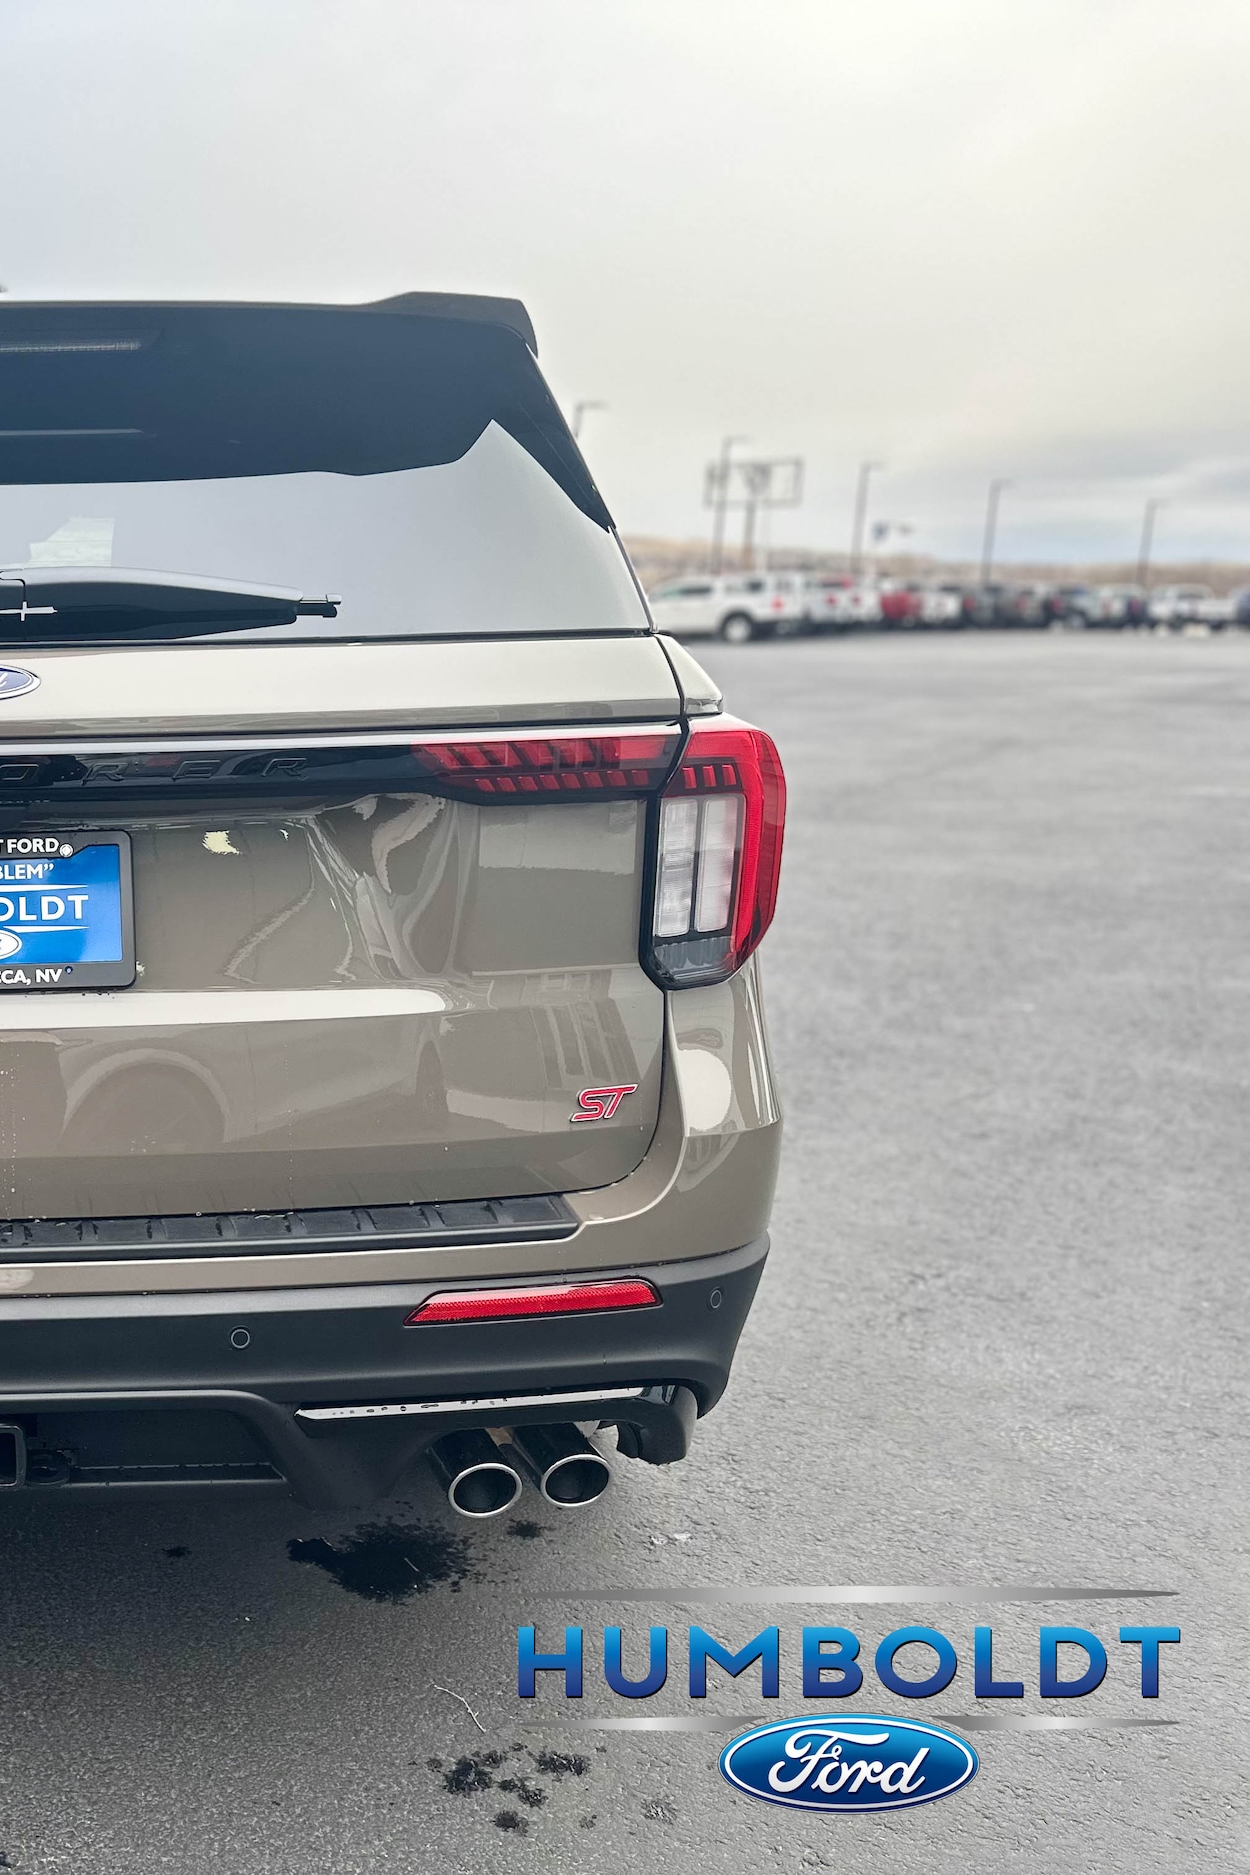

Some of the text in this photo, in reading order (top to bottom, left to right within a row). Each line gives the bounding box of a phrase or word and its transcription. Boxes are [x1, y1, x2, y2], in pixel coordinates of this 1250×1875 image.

[6, 837, 60, 853] FORD
[35, 968, 63, 983] NV
[570, 1083, 639, 1122] ST
